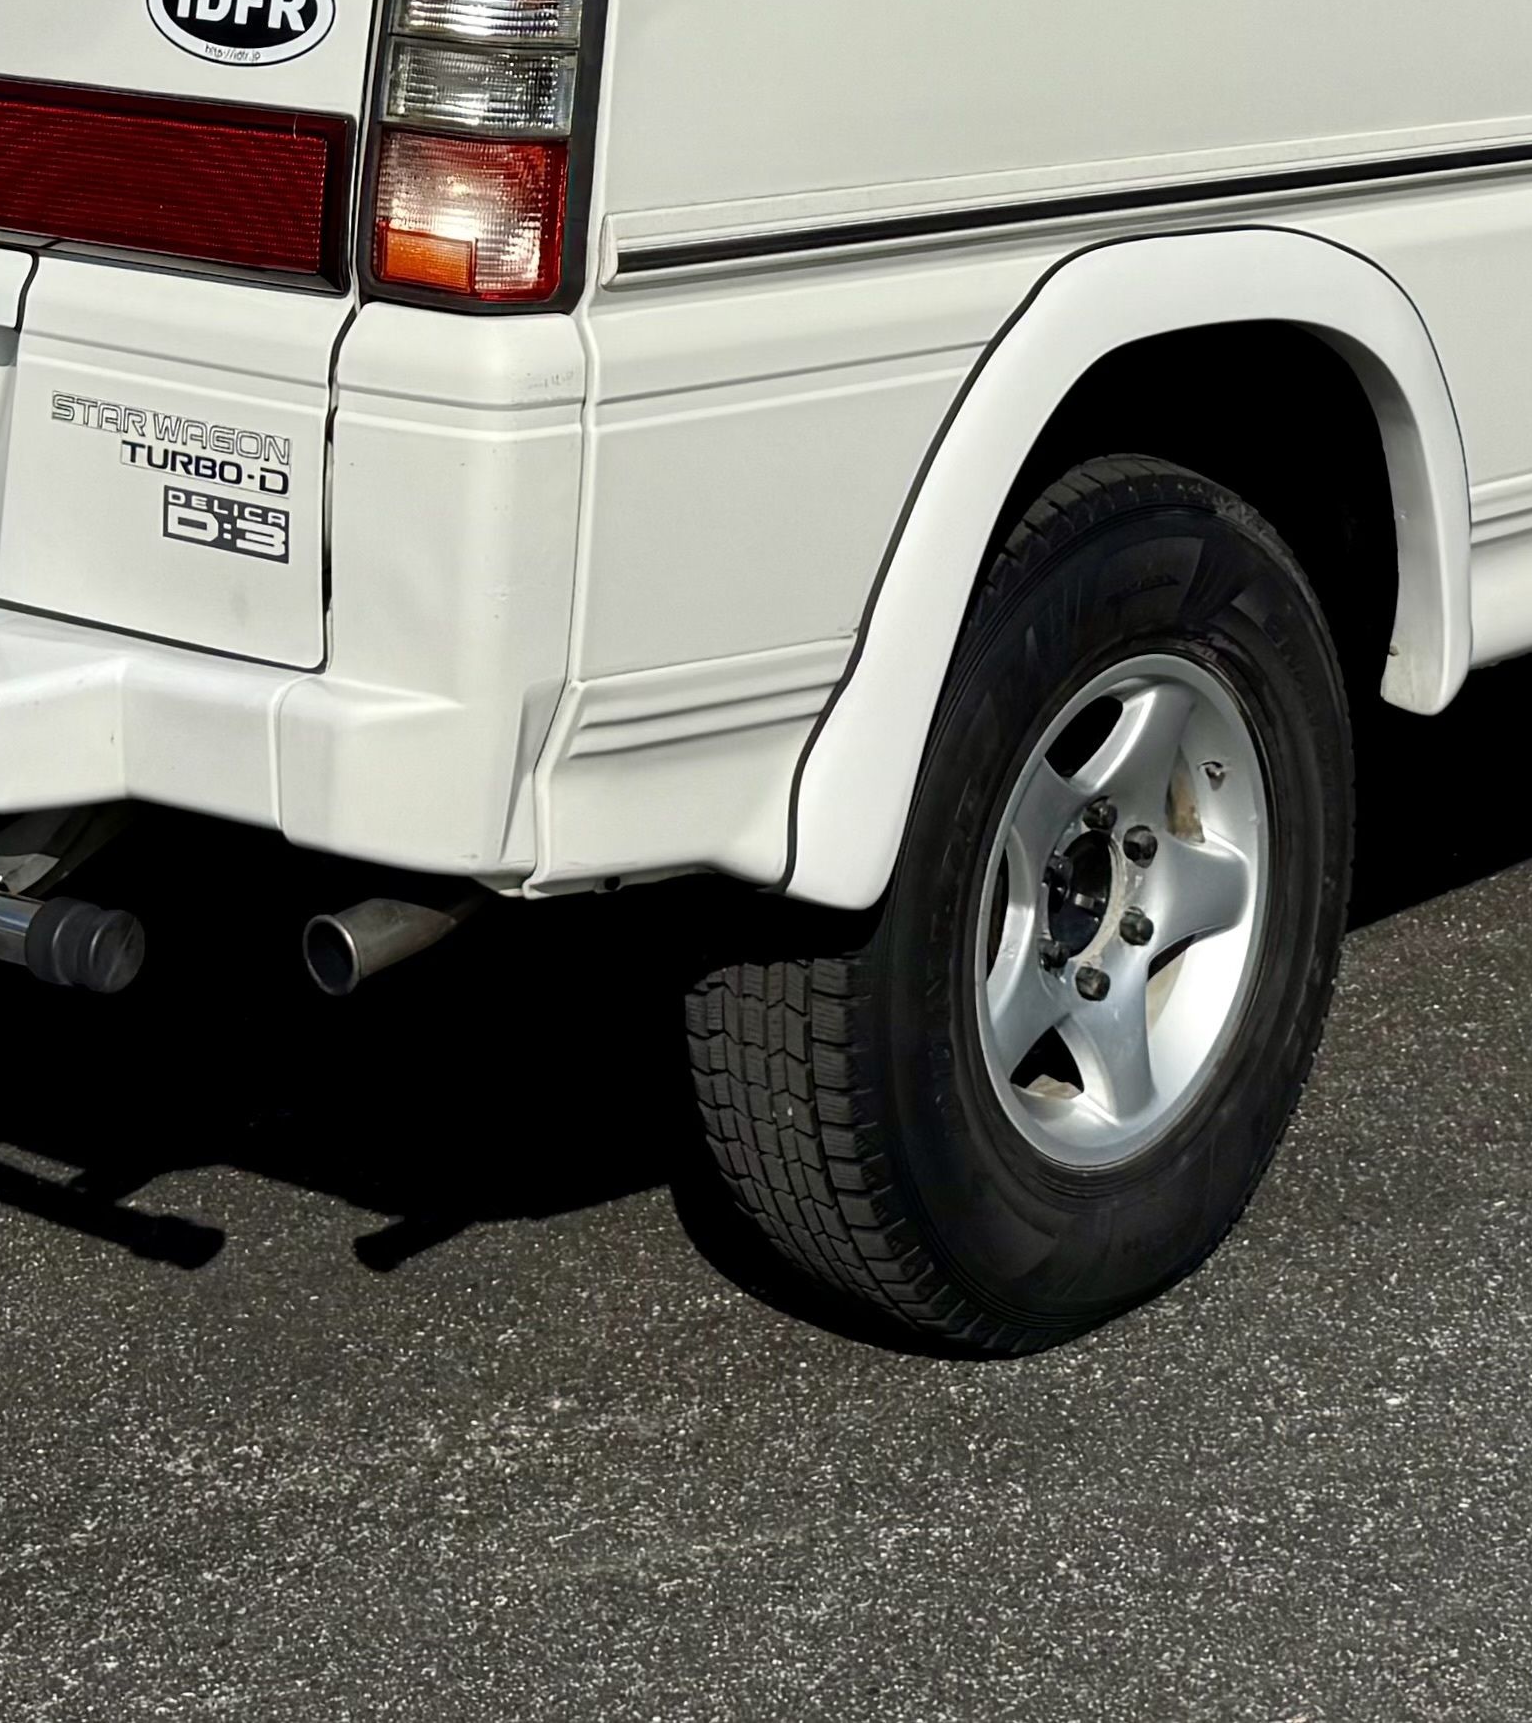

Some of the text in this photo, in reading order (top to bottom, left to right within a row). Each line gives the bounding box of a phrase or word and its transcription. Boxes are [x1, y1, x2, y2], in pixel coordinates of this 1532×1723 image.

[52, 393, 291, 465] STAR WAGON
[168, 490, 286, 526] DELICA
